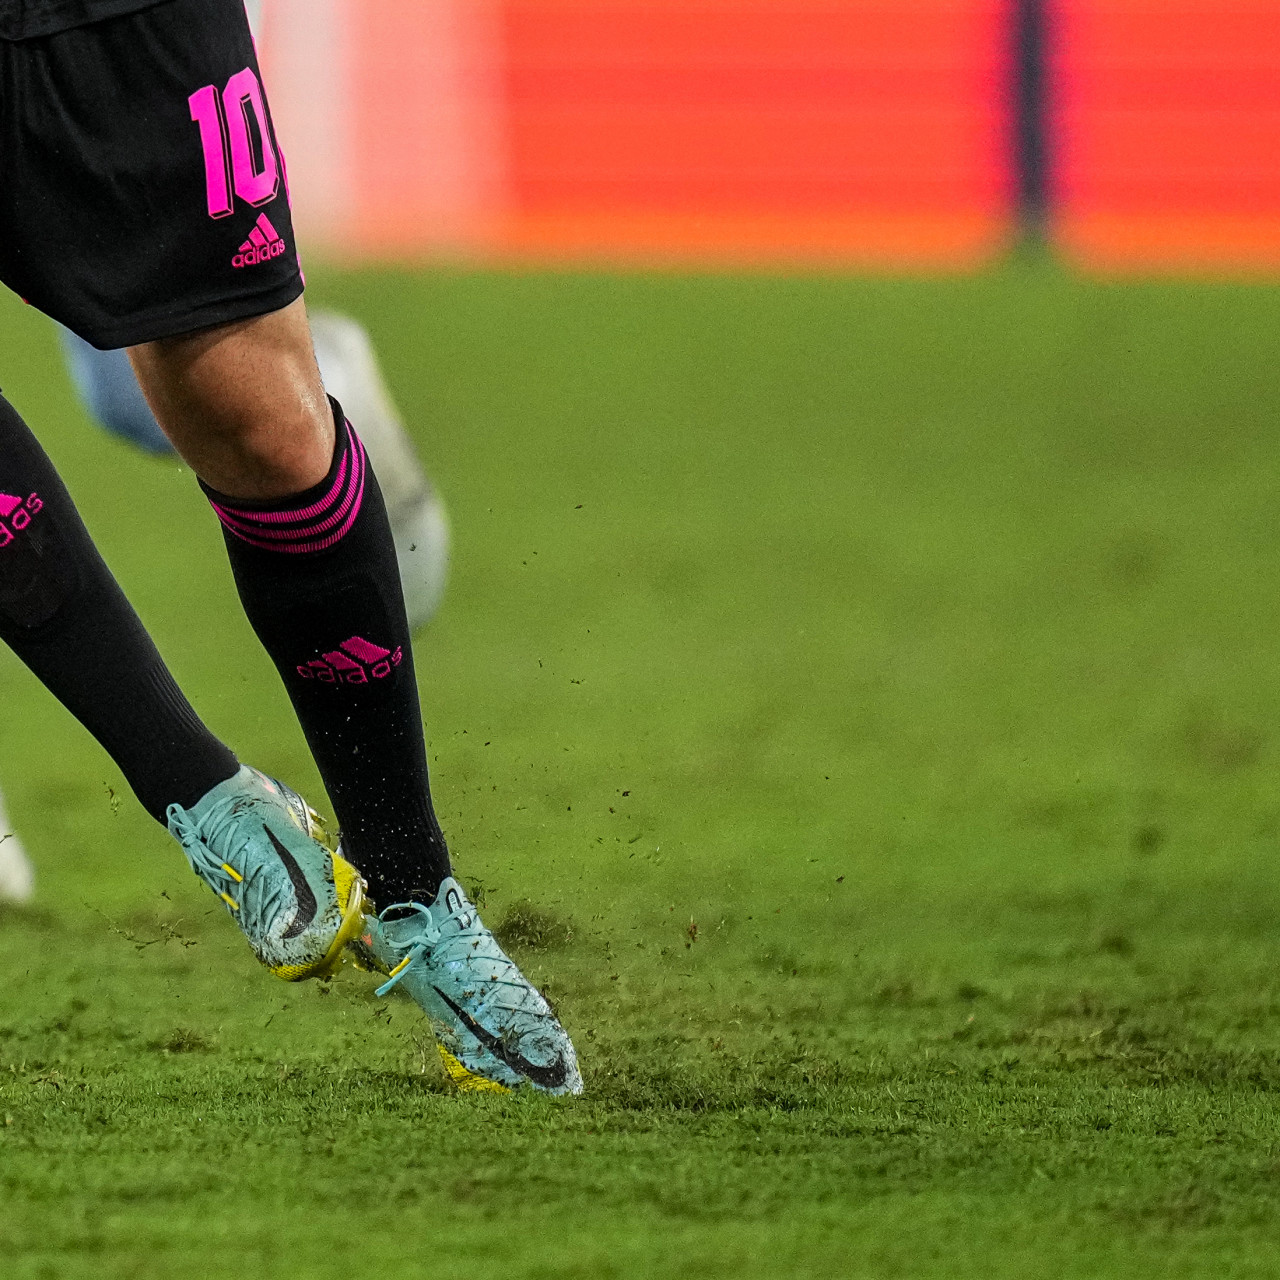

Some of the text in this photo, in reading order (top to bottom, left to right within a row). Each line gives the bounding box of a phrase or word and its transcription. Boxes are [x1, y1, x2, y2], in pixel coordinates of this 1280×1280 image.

[188, 67, 279, 219] 10
[231, 238, 286, 269] adidas
[297, 645, 402, 684] adidas
